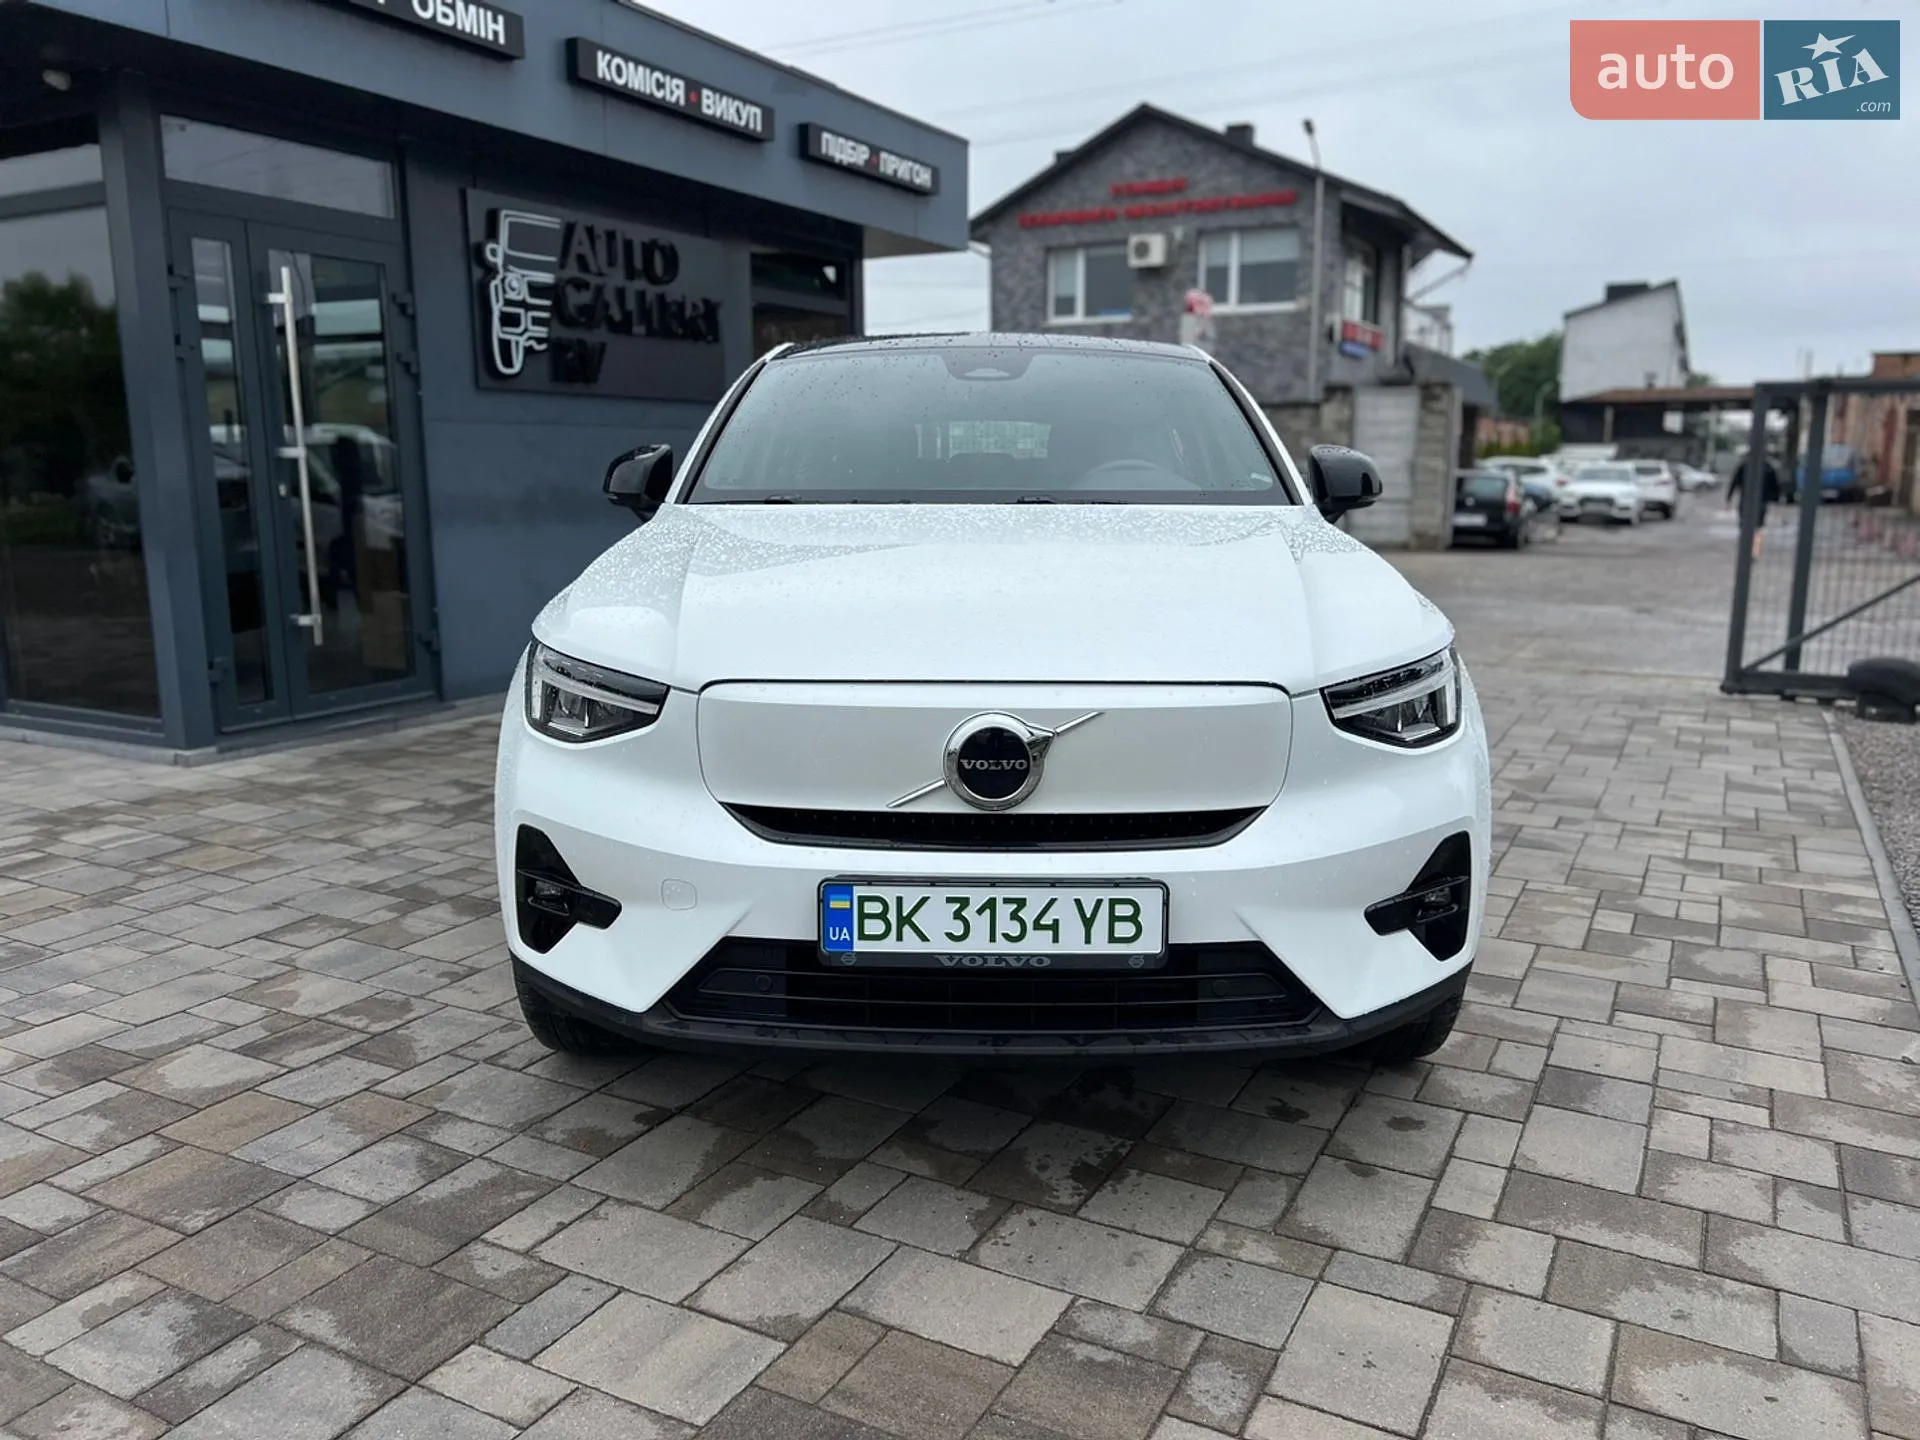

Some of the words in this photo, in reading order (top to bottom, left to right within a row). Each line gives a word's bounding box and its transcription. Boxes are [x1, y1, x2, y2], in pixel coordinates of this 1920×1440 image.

[596, 50, 685, 106] КОМІСІЯ
[701, 88, 763, 133] ВИКУП
[821, 131, 870, 167] ПІДБІР
[879, 151, 932, 189] ПРИГОН
[561, 221, 680, 285] AUTO
[960, 758, 1028, 771] VOLVO
[829, 926, 850, 942] UA
[857, 894, 931, 943] BK
[944, 896, 1060, 945] 3134
[1074, 897, 1143, 945] YB
[933, 954, 1051, 968] VOLVO
